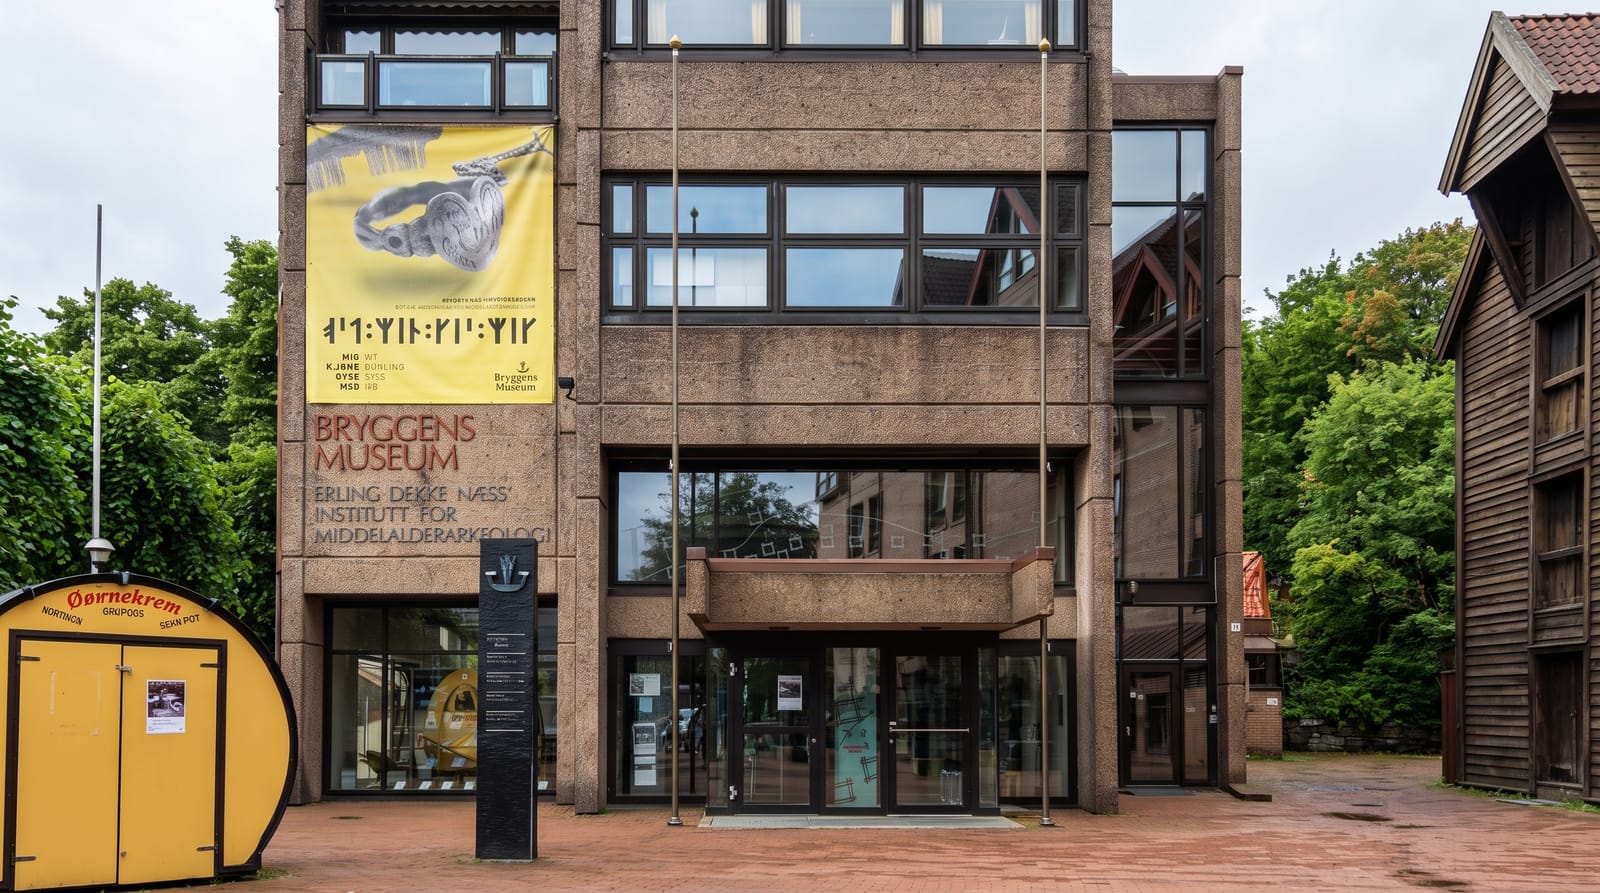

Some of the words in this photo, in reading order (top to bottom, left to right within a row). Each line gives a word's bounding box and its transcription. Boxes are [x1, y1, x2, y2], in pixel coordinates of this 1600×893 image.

[494, 373, 538, 384] Bryggens
[340, 382, 360, 390] MSD
[496, 383, 536, 391] Museum
[313, 414, 476, 442] BRYGGENS
[313, 443, 459, 471] MUSEUM
[314, 485, 380, 502] ERLING
[389, 485, 447, 502] DEKKE
[314, 506, 409, 523] INSTITUTT
[420, 506, 457, 523] FOR
[182, 613, 200, 624] POT
